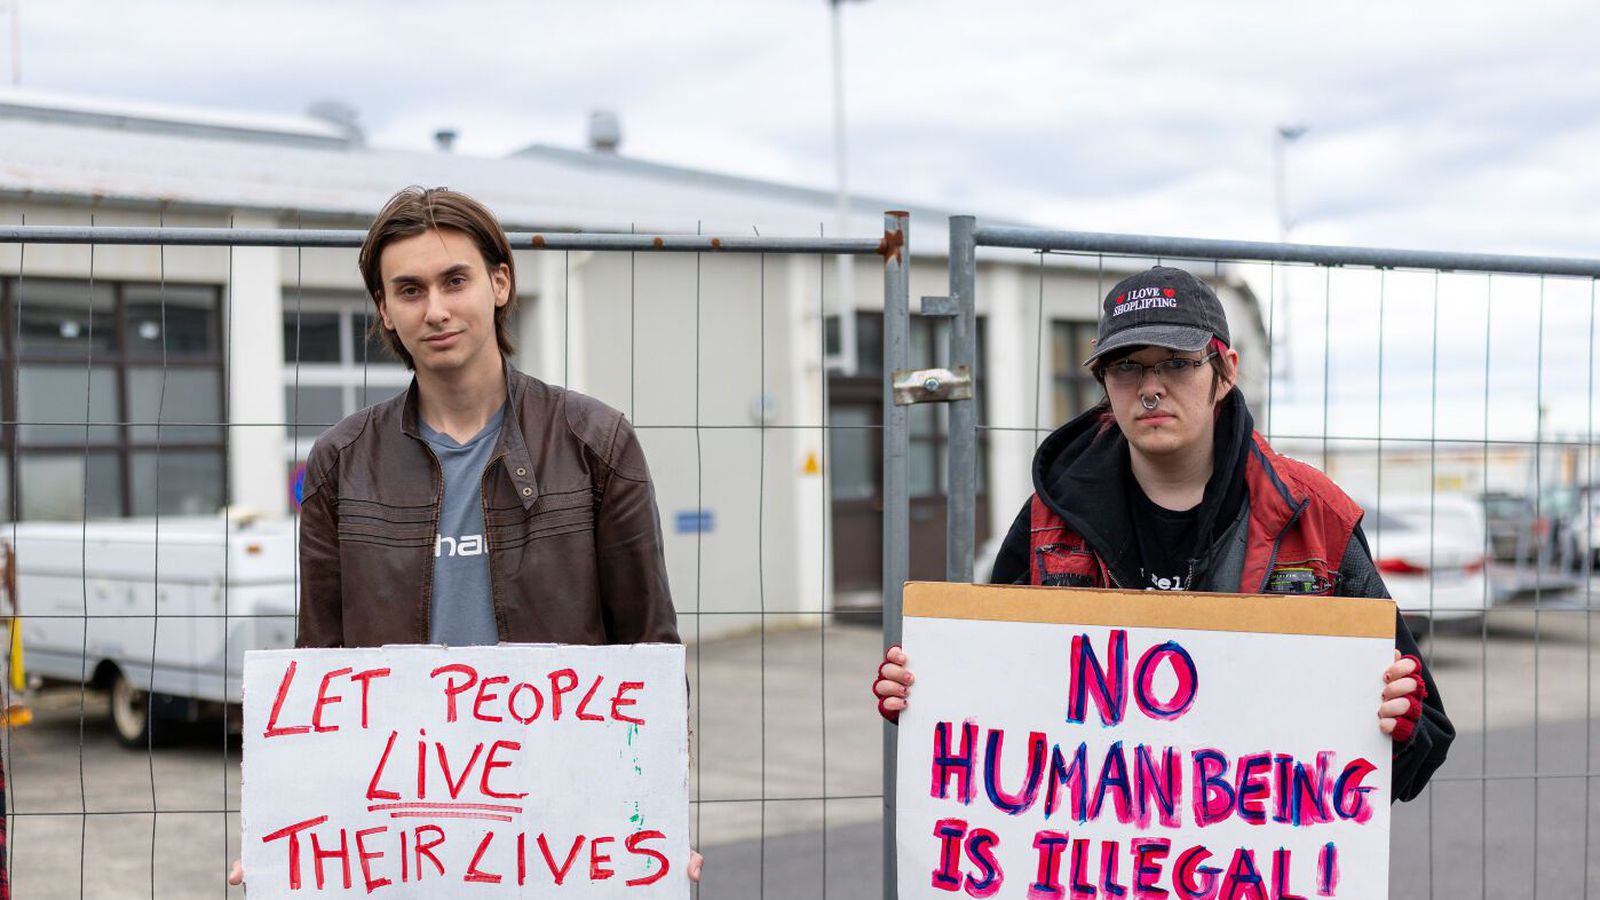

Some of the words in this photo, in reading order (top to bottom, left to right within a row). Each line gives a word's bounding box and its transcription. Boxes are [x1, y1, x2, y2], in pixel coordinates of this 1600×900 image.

[1112, 298, 1176, 316] SHOPLIFTING
[1127, 290, 1132, 301] I
[1132, 288, 1160, 299] LOVE
[263, 660, 391, 737] LET
[430, 663, 646, 726] PEOPLE
[1066, 629, 1199, 727] NO
[930, 718, 1182, 829] HUMAN
[1191, 747, 1379, 828] BEING
[262, 815, 447, 894] THEIR
[463, 829, 671, 888] LIVES
[930, 818, 1004, 899] IS
